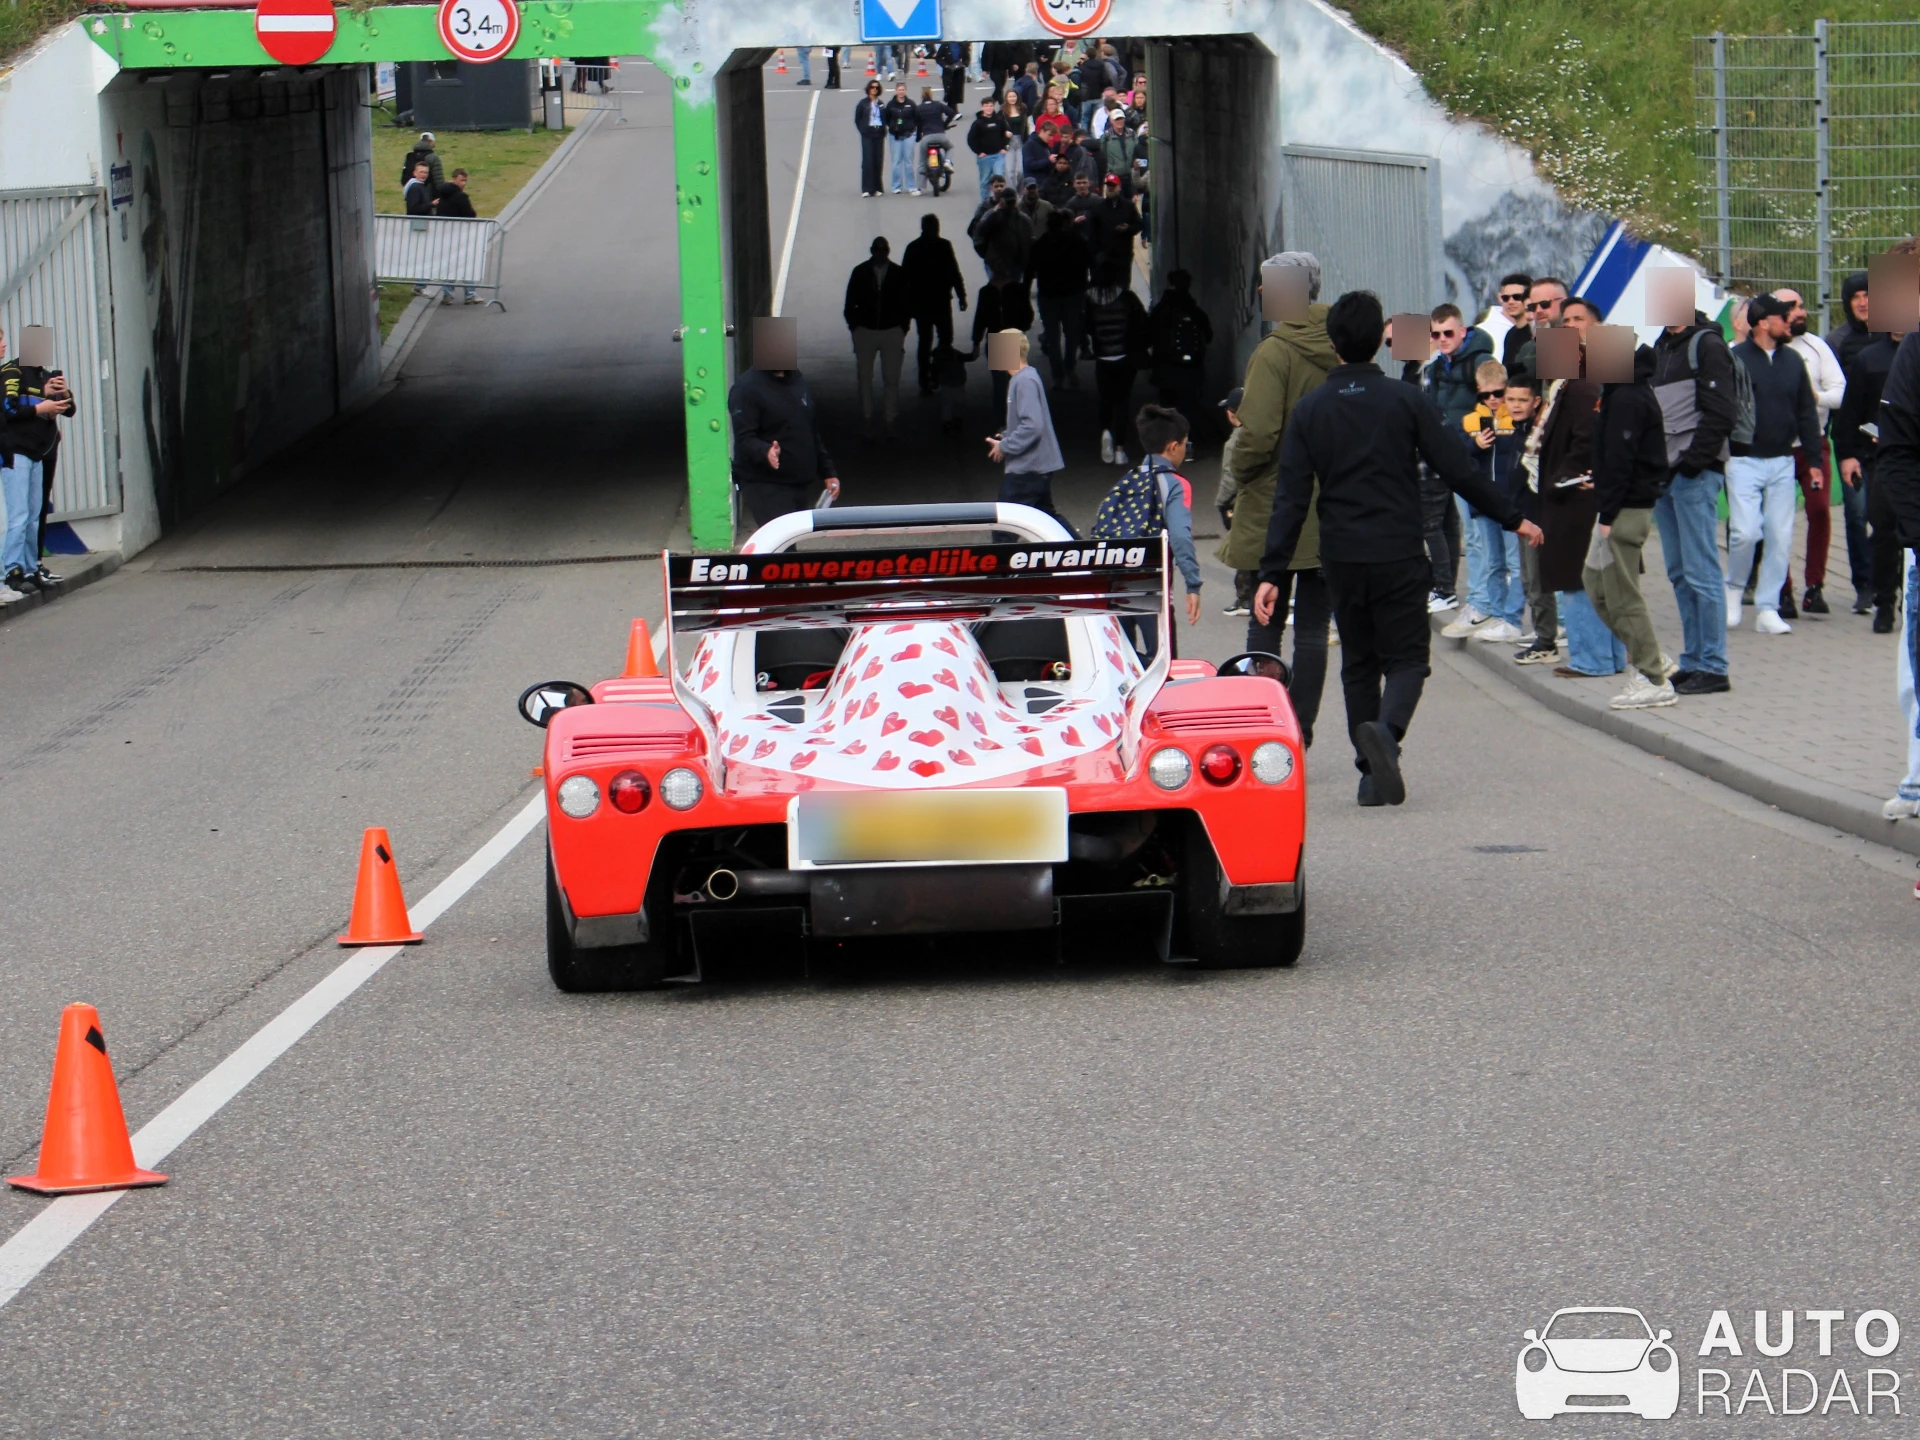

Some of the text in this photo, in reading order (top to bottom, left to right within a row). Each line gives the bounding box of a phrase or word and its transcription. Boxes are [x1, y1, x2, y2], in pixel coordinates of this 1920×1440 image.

[455, 8, 504, 36] 3,4m
[689, 542, 1146, 583] Een onvergetelijke ervaring
